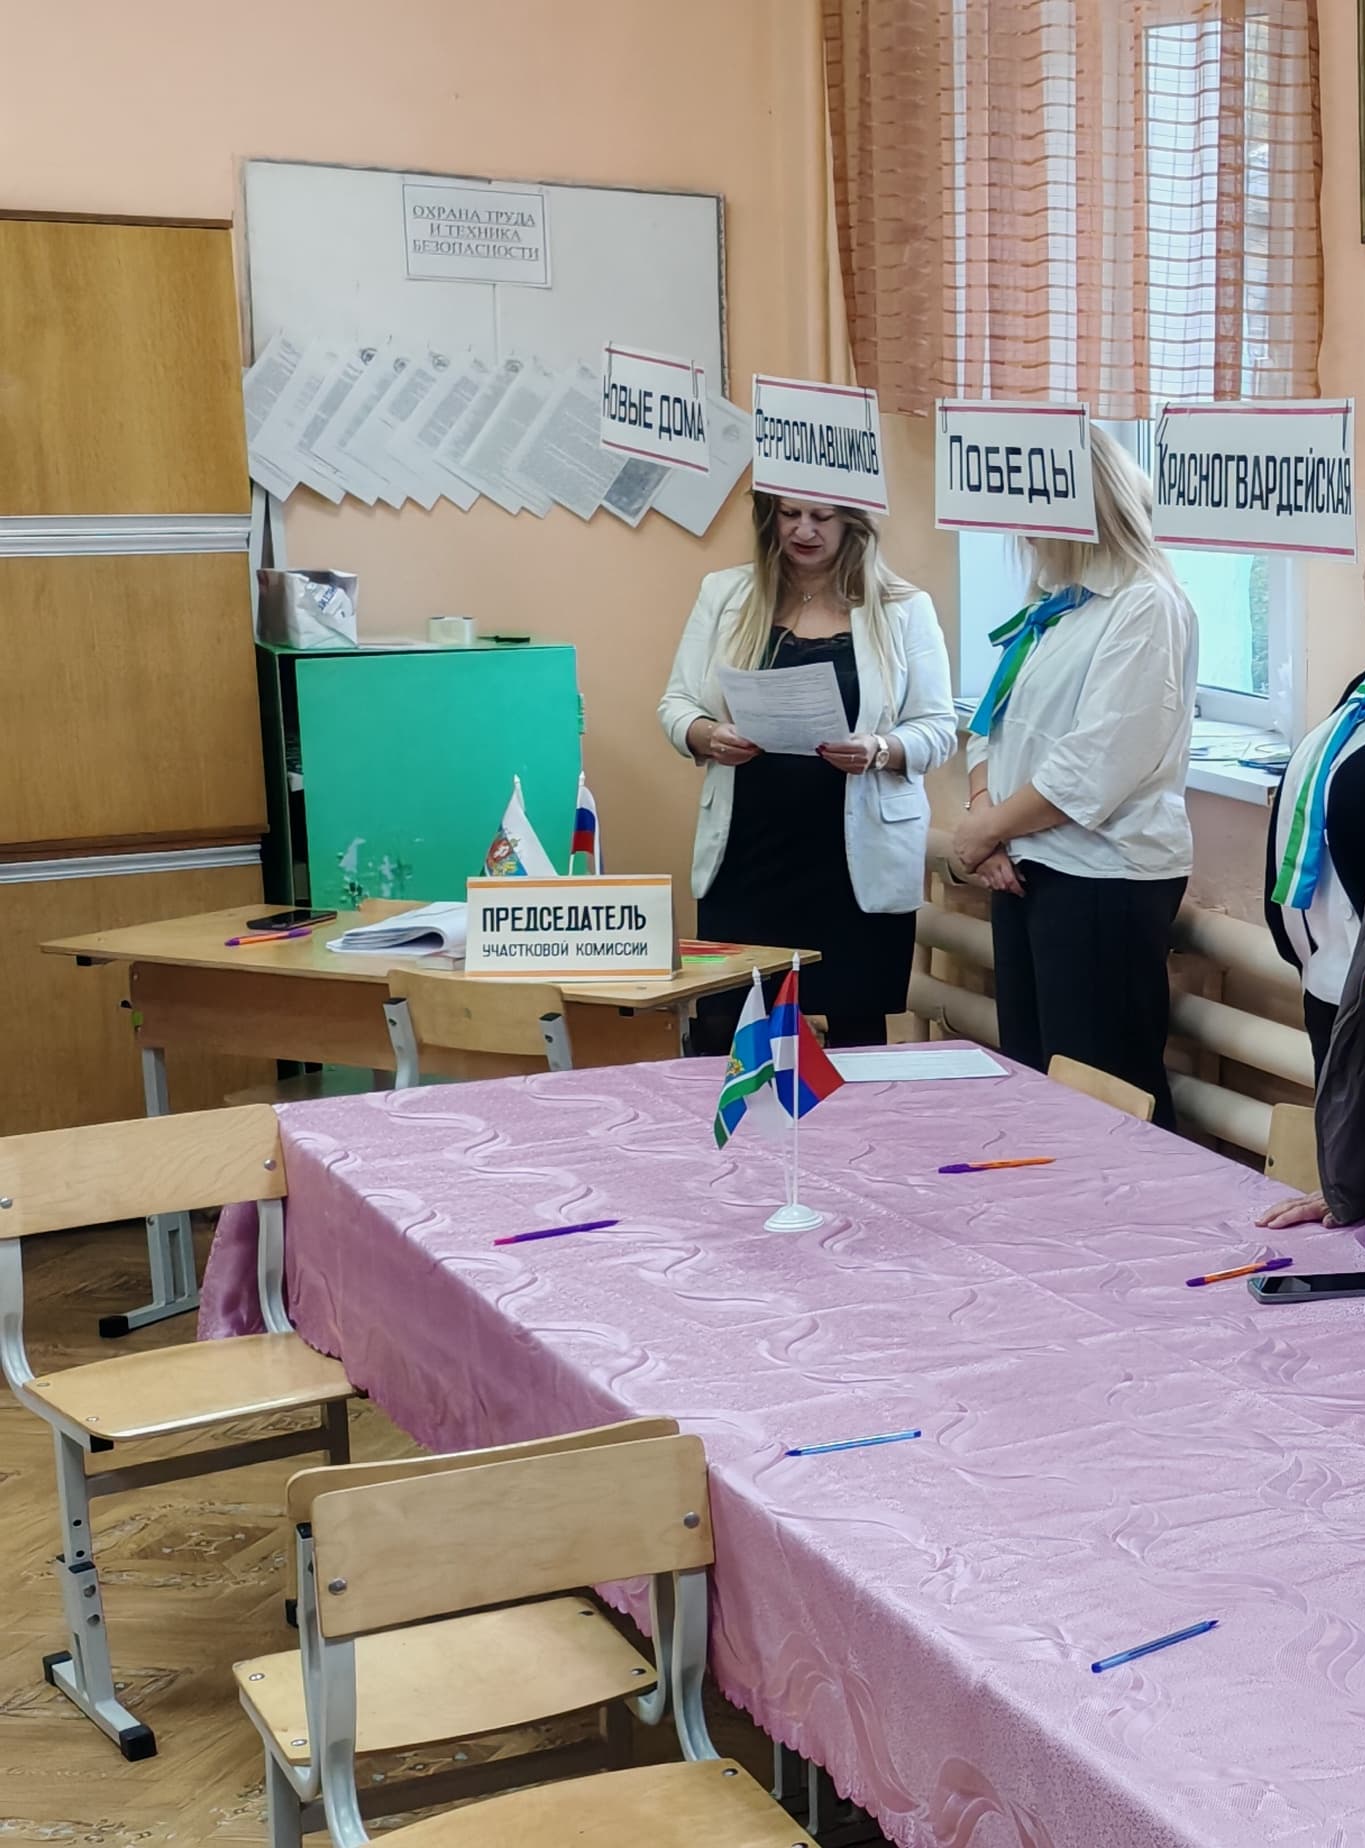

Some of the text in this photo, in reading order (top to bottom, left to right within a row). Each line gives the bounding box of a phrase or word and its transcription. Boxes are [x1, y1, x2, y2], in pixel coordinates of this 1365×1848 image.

[412, 205, 536, 226] ОХРАНА ТРУДА
[429, 222, 522, 241] И ТЕХНИКА
[412, 239, 539, 261] БЕЗОПАСНОСТИ
[602, 375, 706, 443] НОВЫЕ ДОМА
[755, 408, 880, 475] ФЕРРОСПЛАВЩИКОВ
[948, 435, 1077, 505] ПОБЕДЫ
[1157, 443, 1352, 517] КРАСНОГВАРДЕЙСКАЯ
[482, 905, 647, 932] ПРЕДСЕДАТЕЛЬ
[482, 940, 648, 957] УЧАСТКОВОЙ КОМИССИИ
